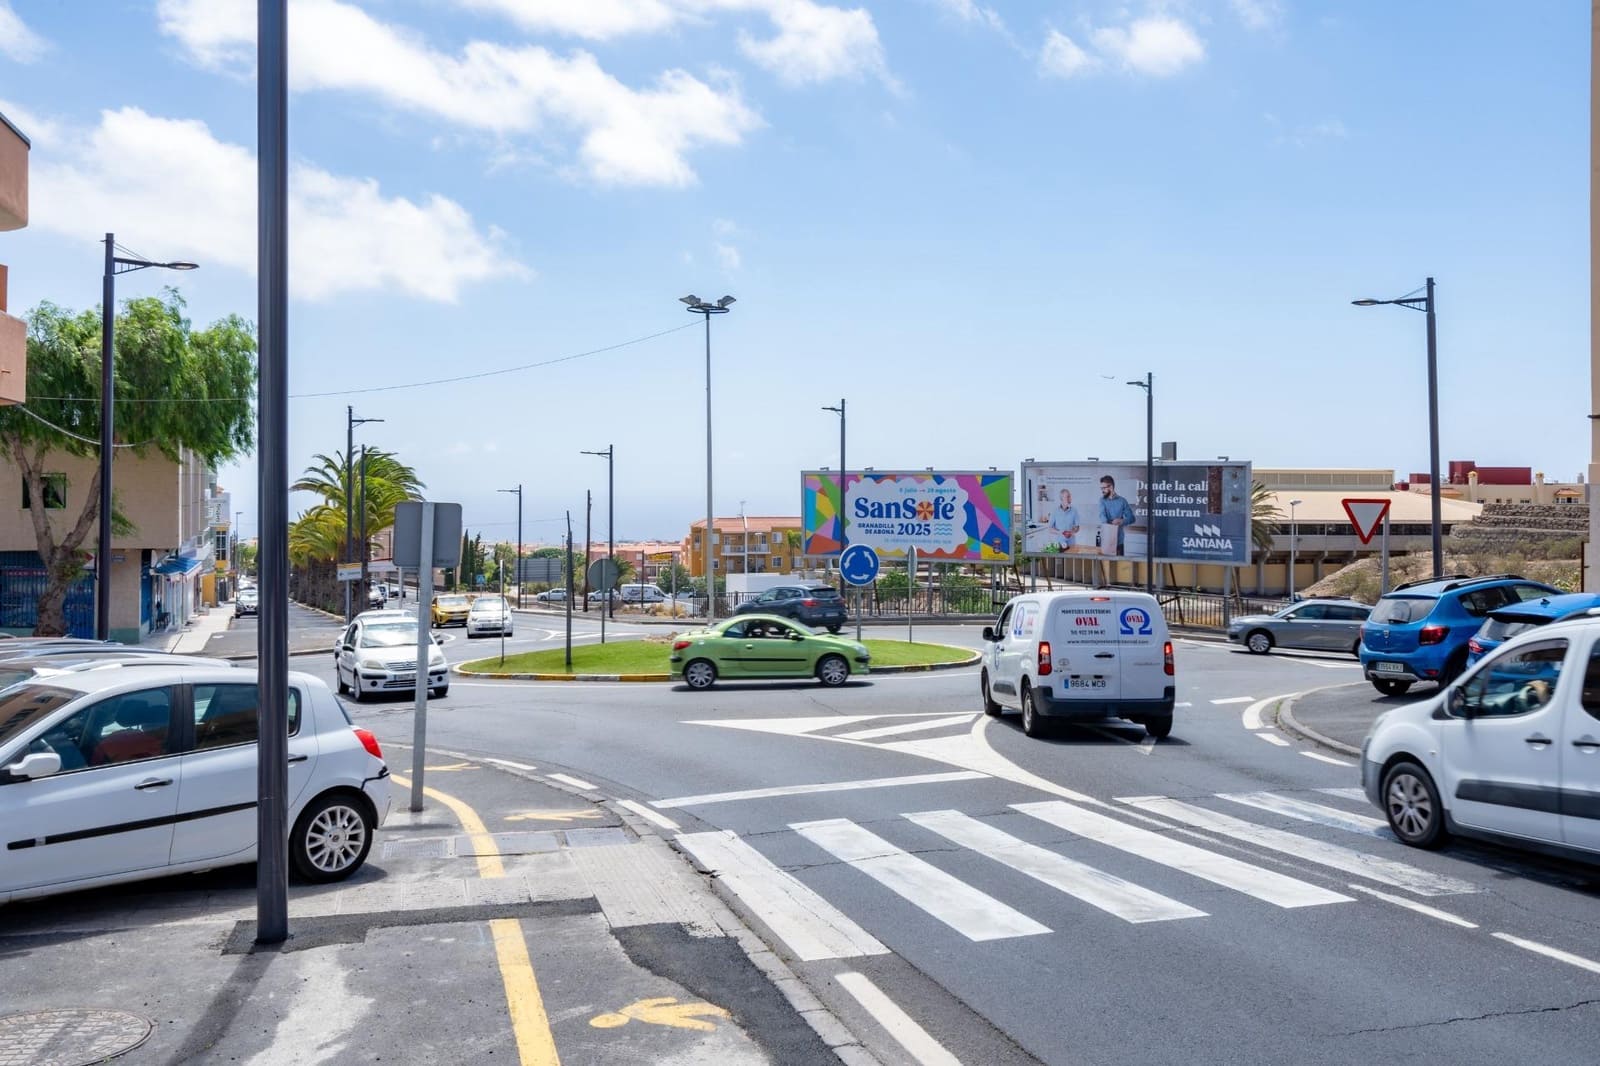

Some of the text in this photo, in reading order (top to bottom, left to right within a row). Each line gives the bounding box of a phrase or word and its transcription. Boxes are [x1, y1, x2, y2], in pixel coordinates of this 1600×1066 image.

[1175, 480, 1186, 491] la
[1135, 495, 1142, 506] y
[1156, 494, 1194, 504] diseño
[1196, 496, 1208, 505] se
[854, 496, 956, 521] SanSofé
[897, 523, 931, 536] 2025
[1182, 537, 1233, 550] SANTANA
[1075, 617, 1100, 626] OVAL
[1126, 615, 1145, 623] OVAL
